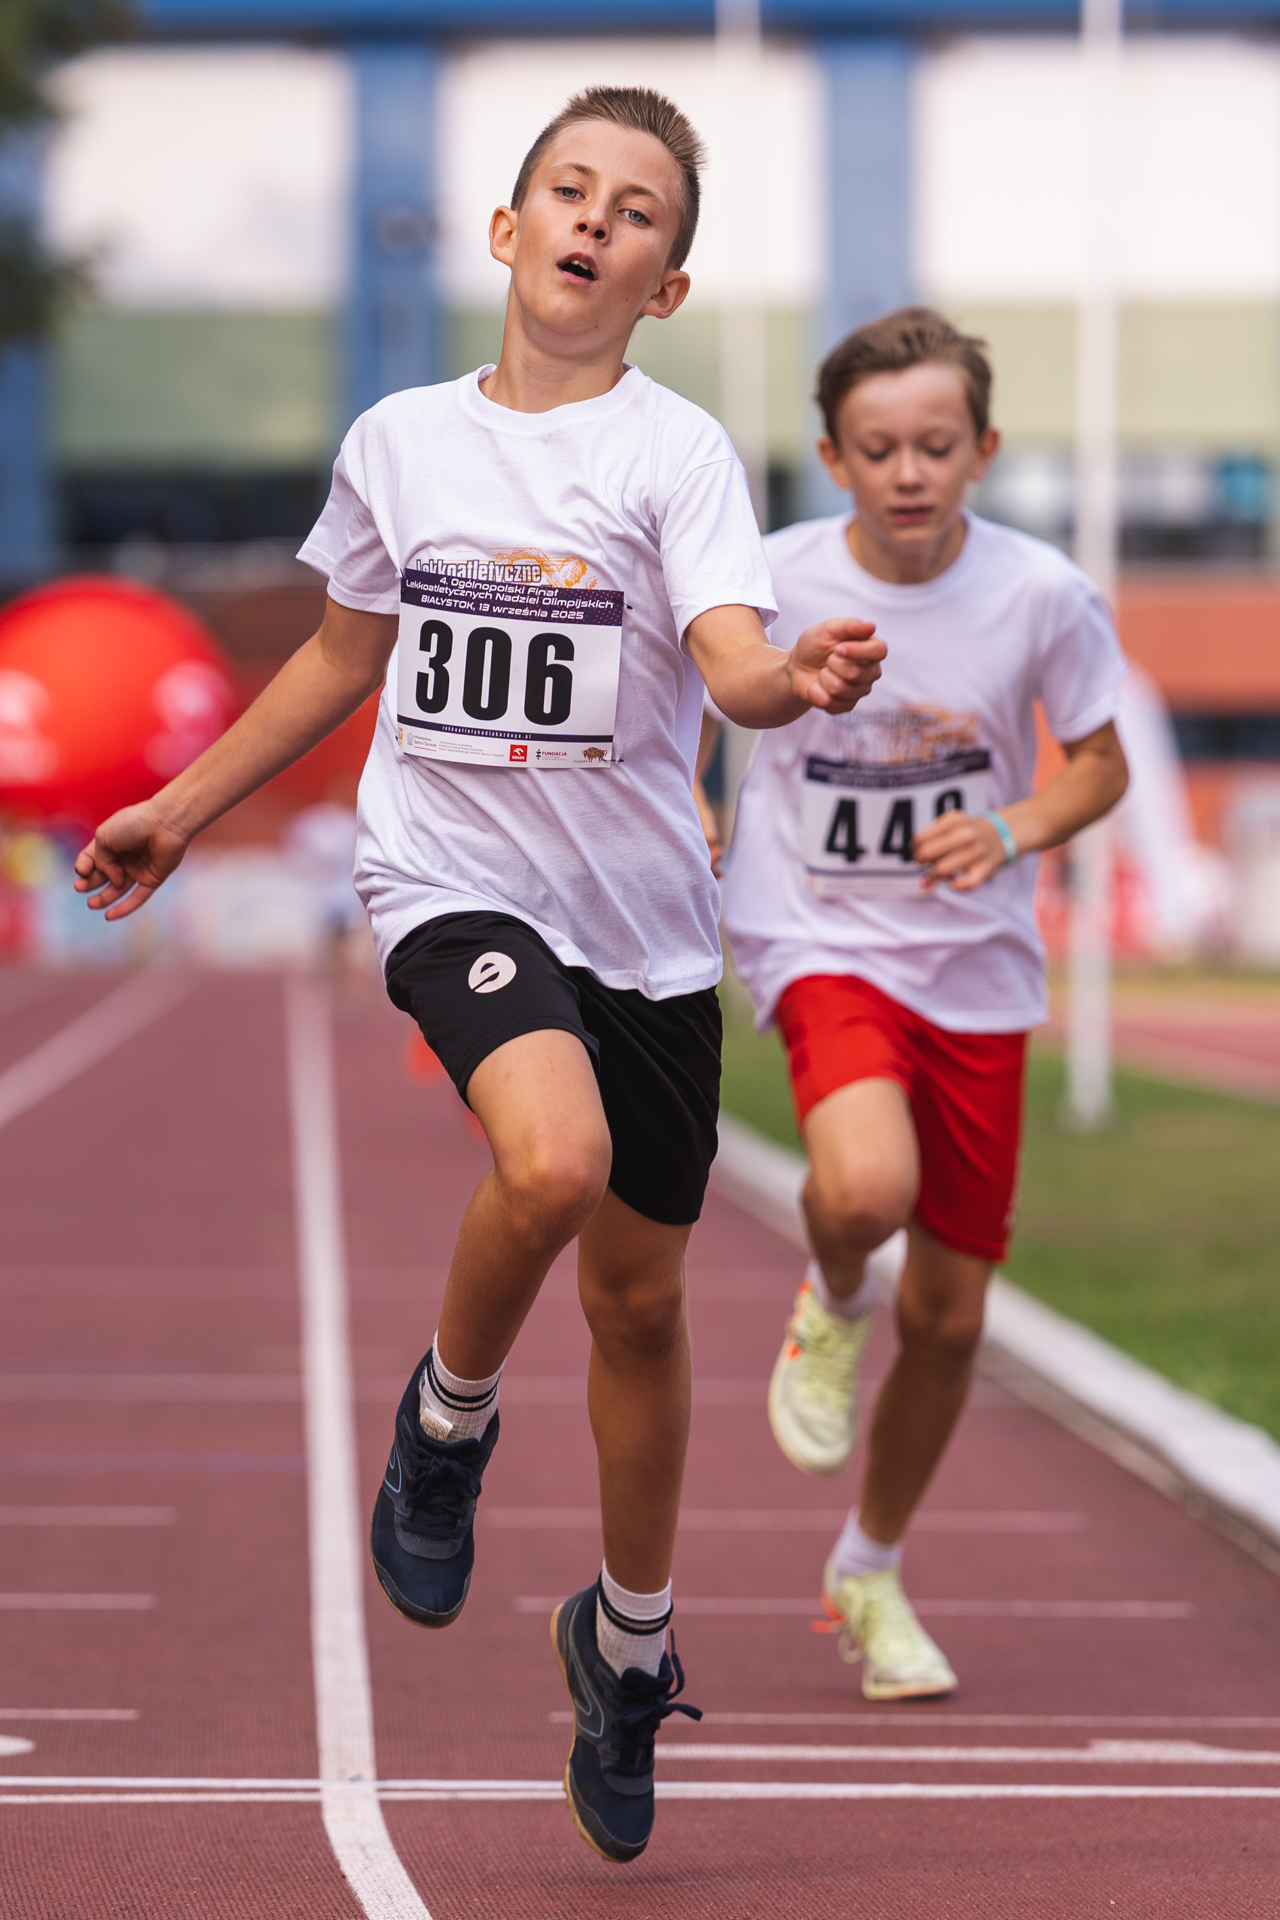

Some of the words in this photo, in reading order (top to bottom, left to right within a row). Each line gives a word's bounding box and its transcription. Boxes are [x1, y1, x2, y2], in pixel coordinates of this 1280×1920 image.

[405, 579, 492, 600] Lekkoatletycznych
[495, 592, 539, 602] Nadziei
[541, 597, 614, 609] Olimpijskich
[451, 578, 525, 595] Ogólnopolski
[421, 594, 476, 611] BIAŁYSTOK,
[479, 603, 490, 611] 13
[492, 605, 548, 617] września
[550, 609, 585, 620] 2025
[415, 619, 575, 726] 306
[825, 789, 963, 862] 44
